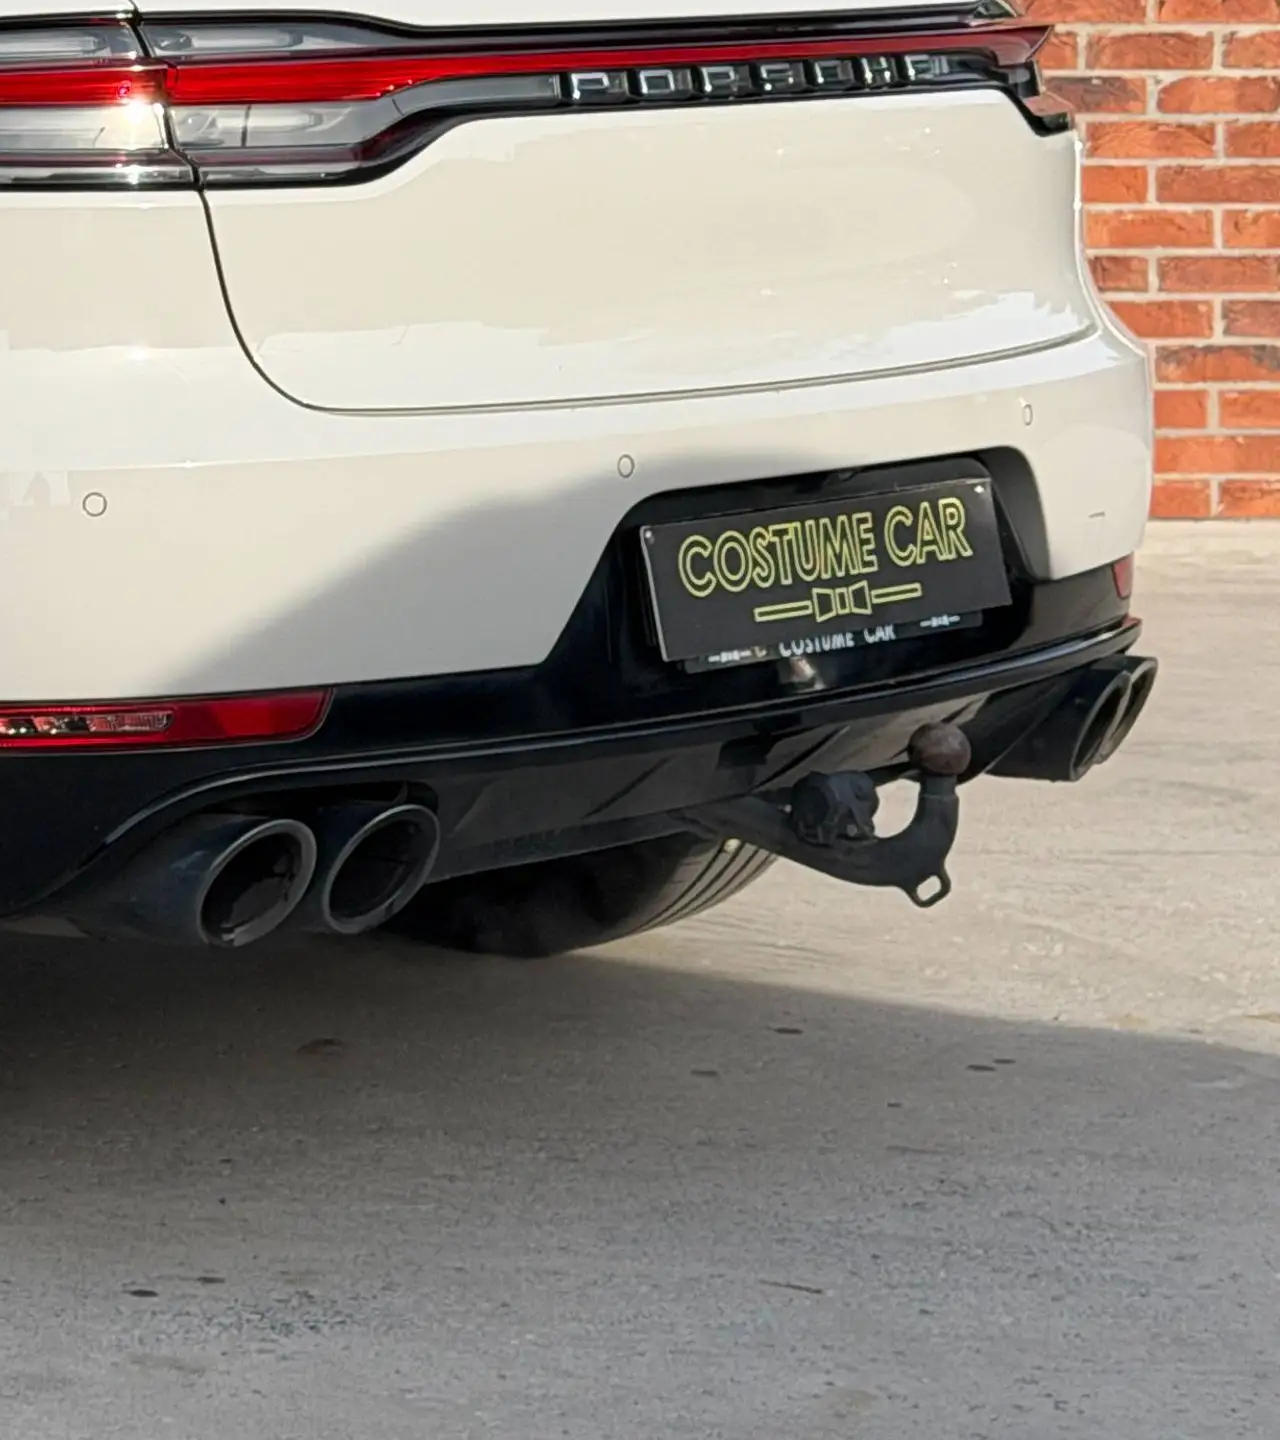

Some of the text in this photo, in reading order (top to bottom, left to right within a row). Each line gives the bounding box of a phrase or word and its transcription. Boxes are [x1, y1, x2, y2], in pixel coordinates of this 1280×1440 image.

[569, 53, 947, 101] PORSCHE
[678, 497, 973, 597] COSTUME CAR
